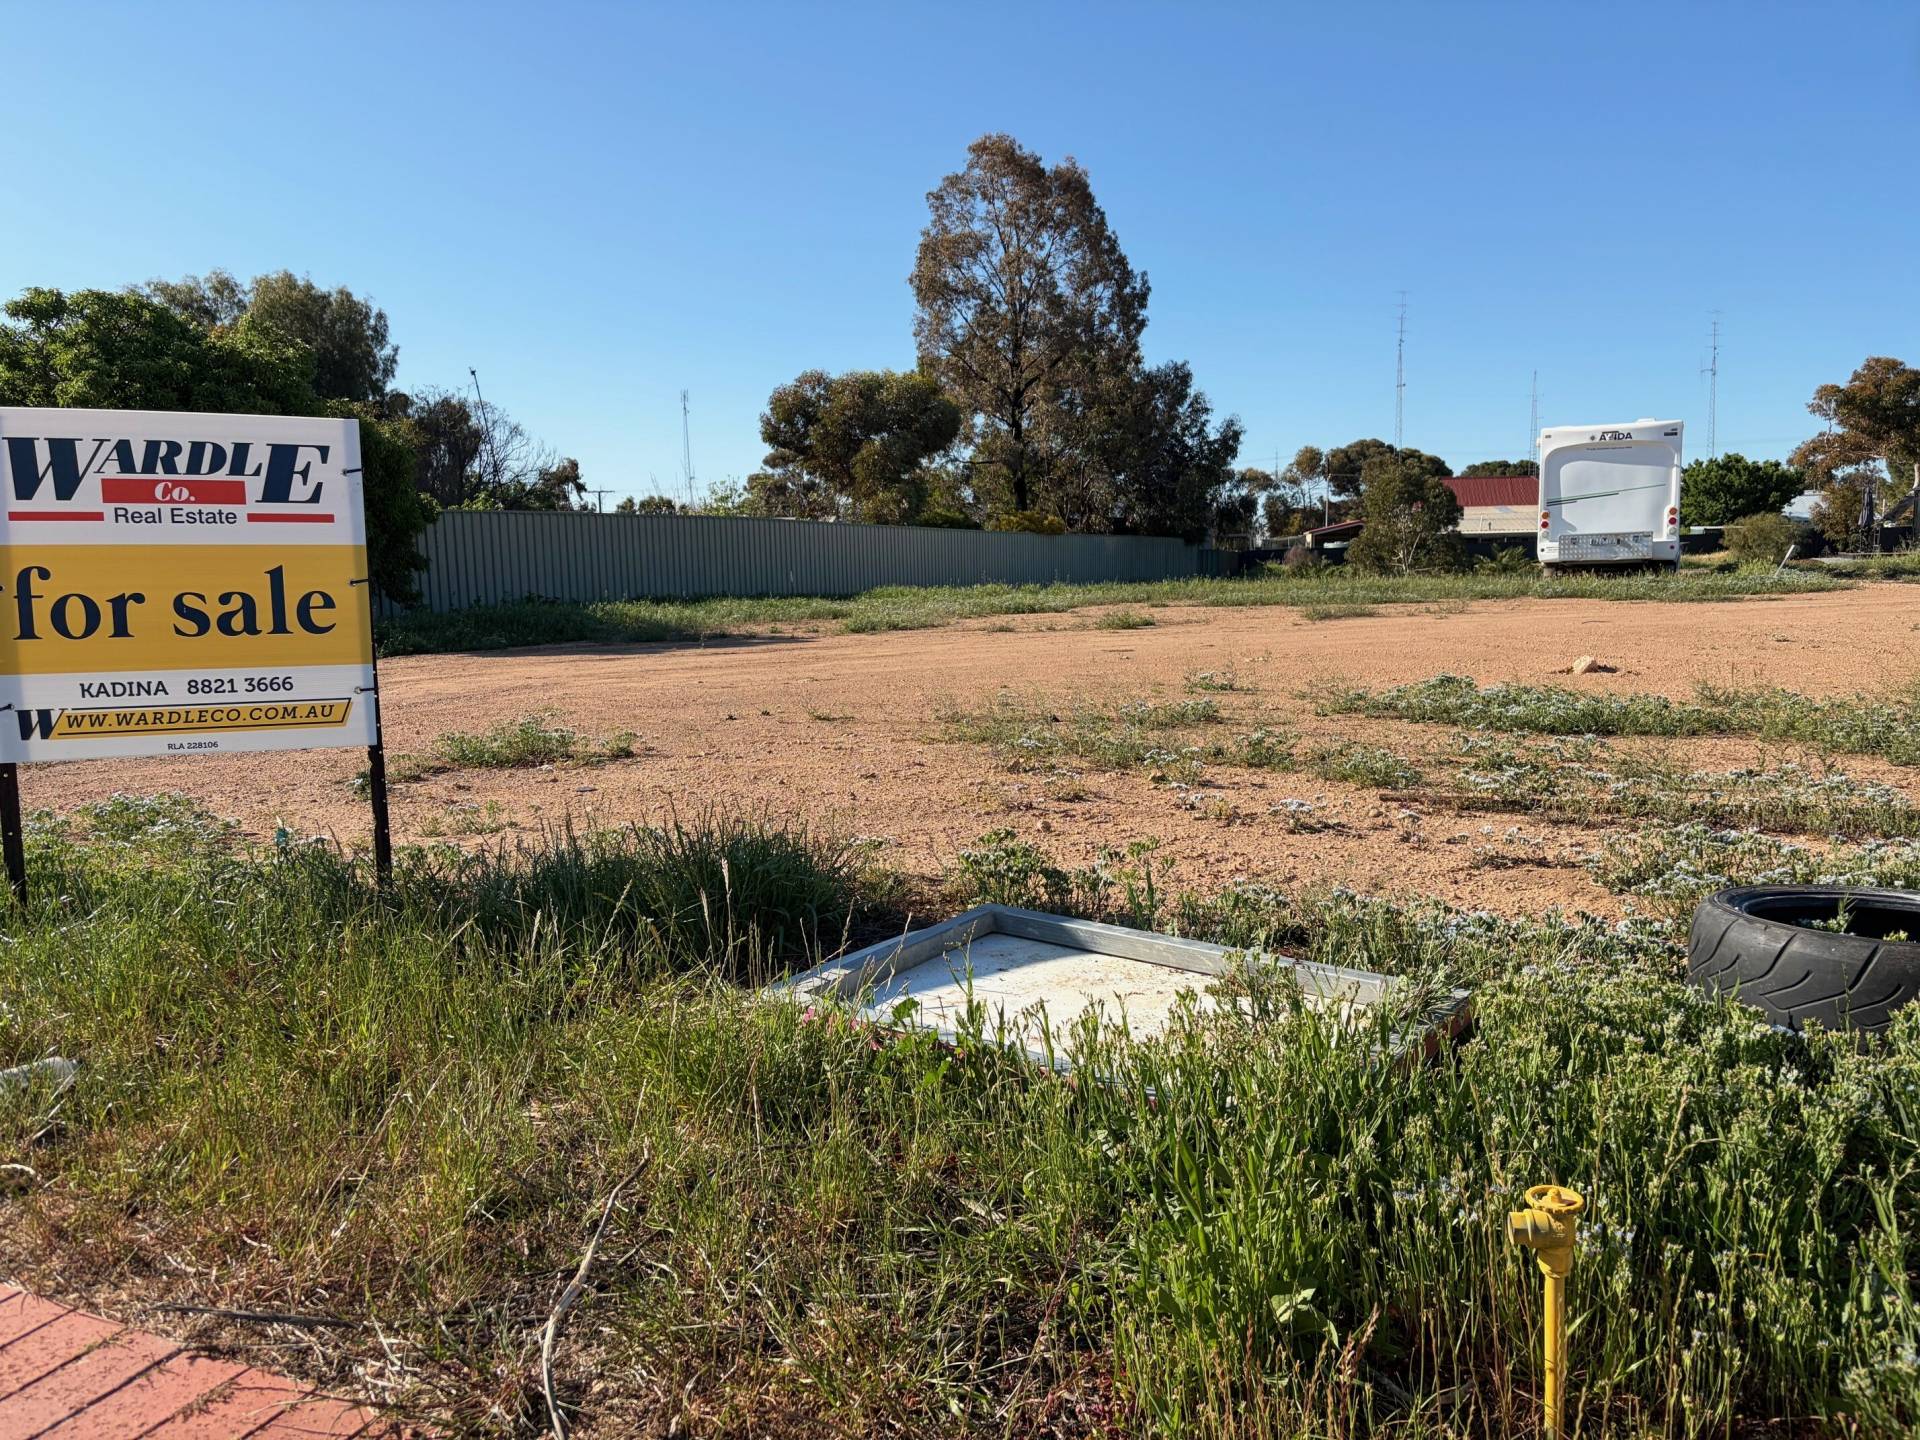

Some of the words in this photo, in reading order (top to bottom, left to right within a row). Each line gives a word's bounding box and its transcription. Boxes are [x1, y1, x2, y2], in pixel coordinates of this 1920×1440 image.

[2, 437, 330, 504] WARDLE
[114, 507, 162, 524] Real
[171, 509, 237, 525] Estate
[13, 566, 146, 640] for
[172, 565, 337, 637] sale
[80, 681, 169, 698] KADINA
[187, 678, 238, 695] 8821
[244, 676, 294, 693] 3666
[167, 743, 185, 751] RLA
[187, 741, 219, 749] 228106
